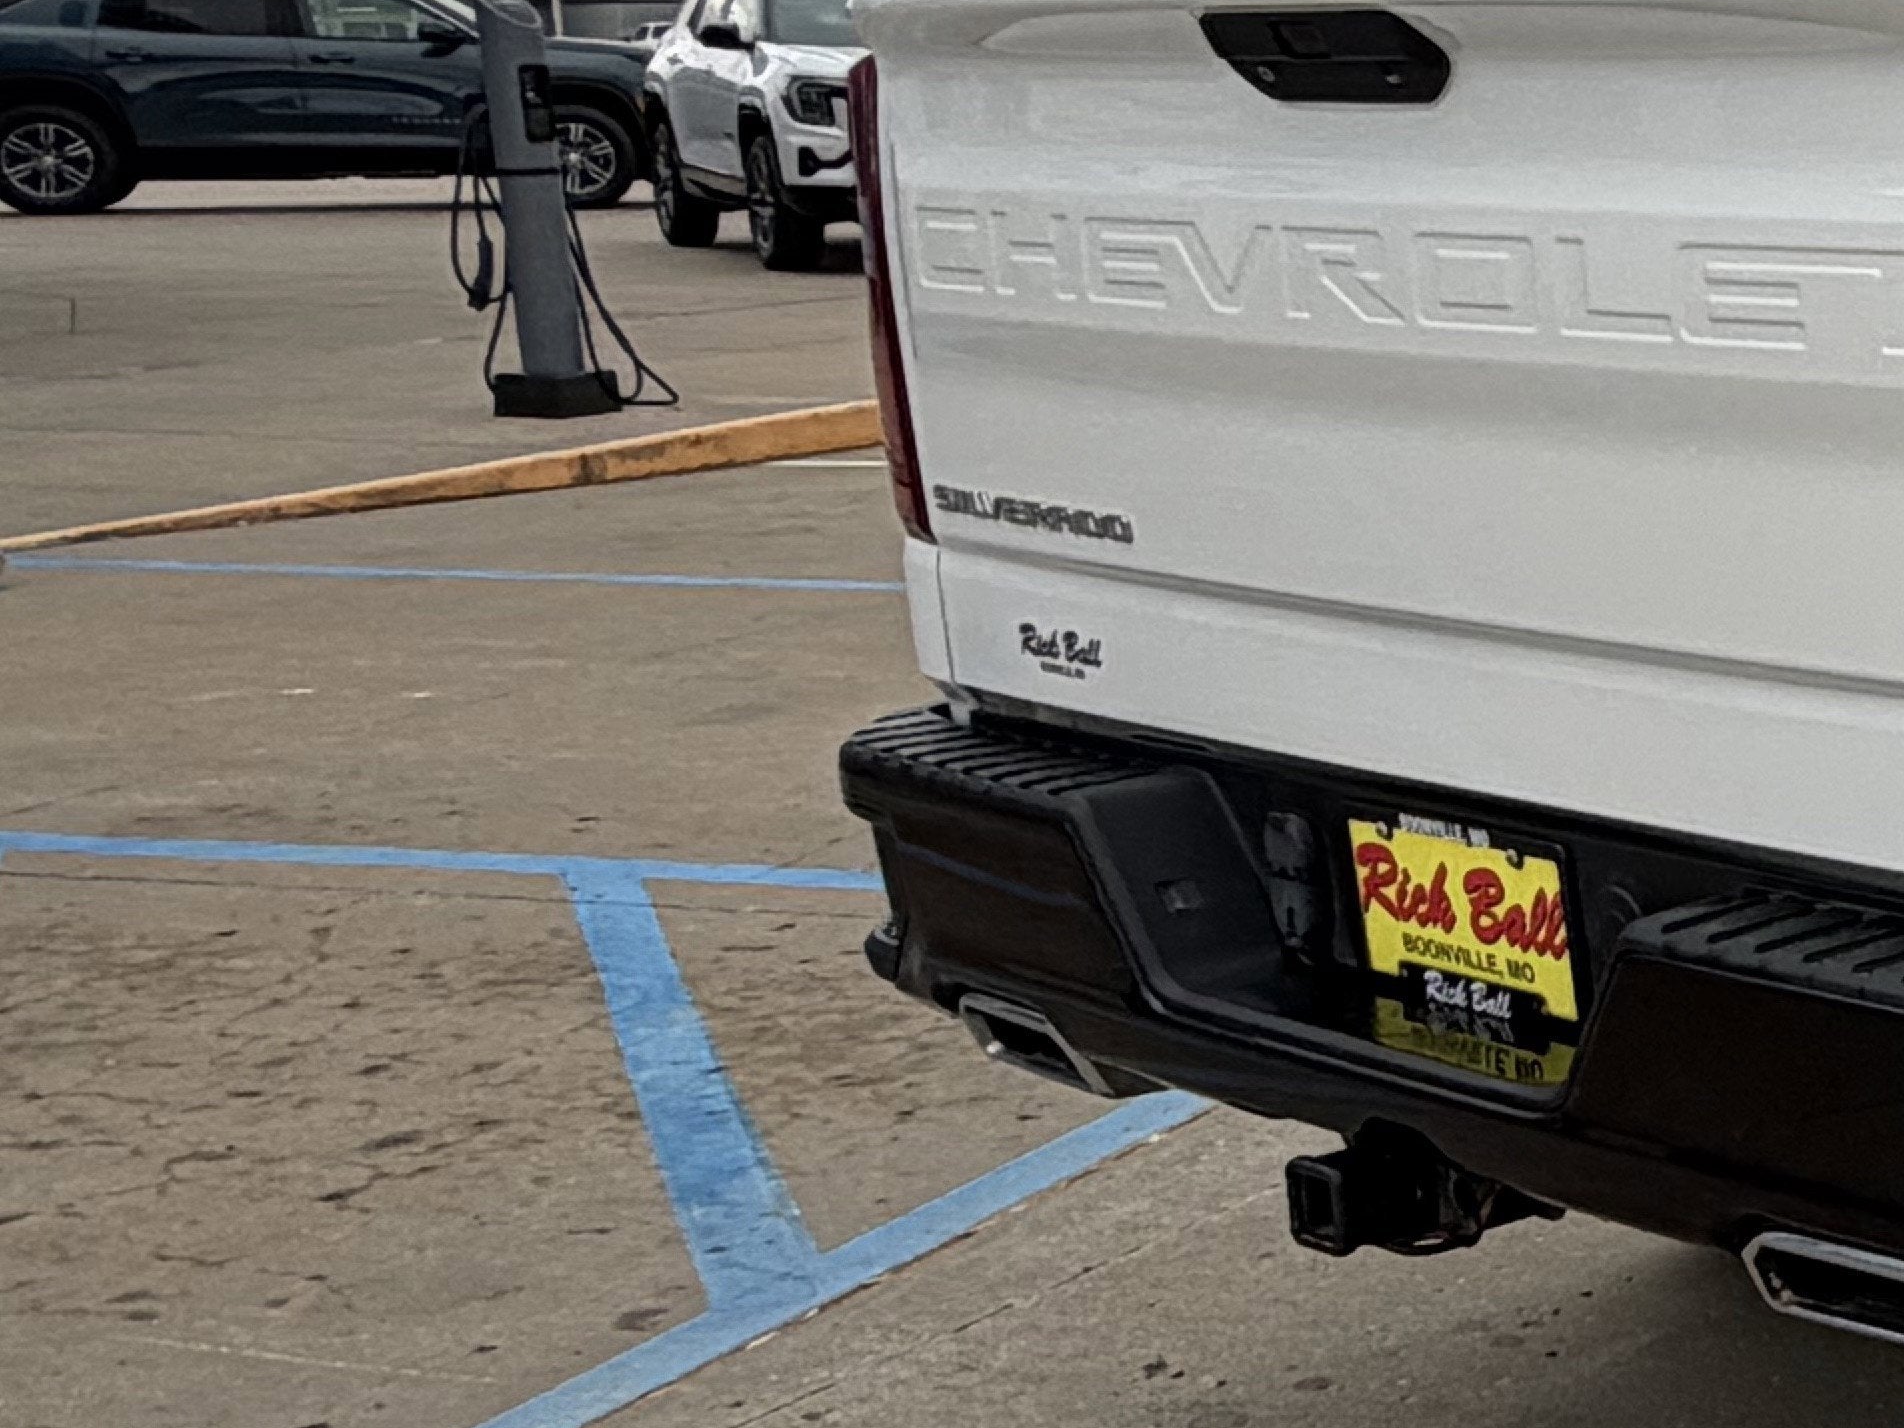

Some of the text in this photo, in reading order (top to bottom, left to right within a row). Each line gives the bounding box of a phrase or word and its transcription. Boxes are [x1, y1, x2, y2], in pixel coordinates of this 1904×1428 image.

[932, 483, 1135, 545] SILVERADO
[1356, 841, 1569, 961] Rick Ball
[1422, 970, 1513, 1020] Rick Ball
[1505, 957, 1537, 984] MO
